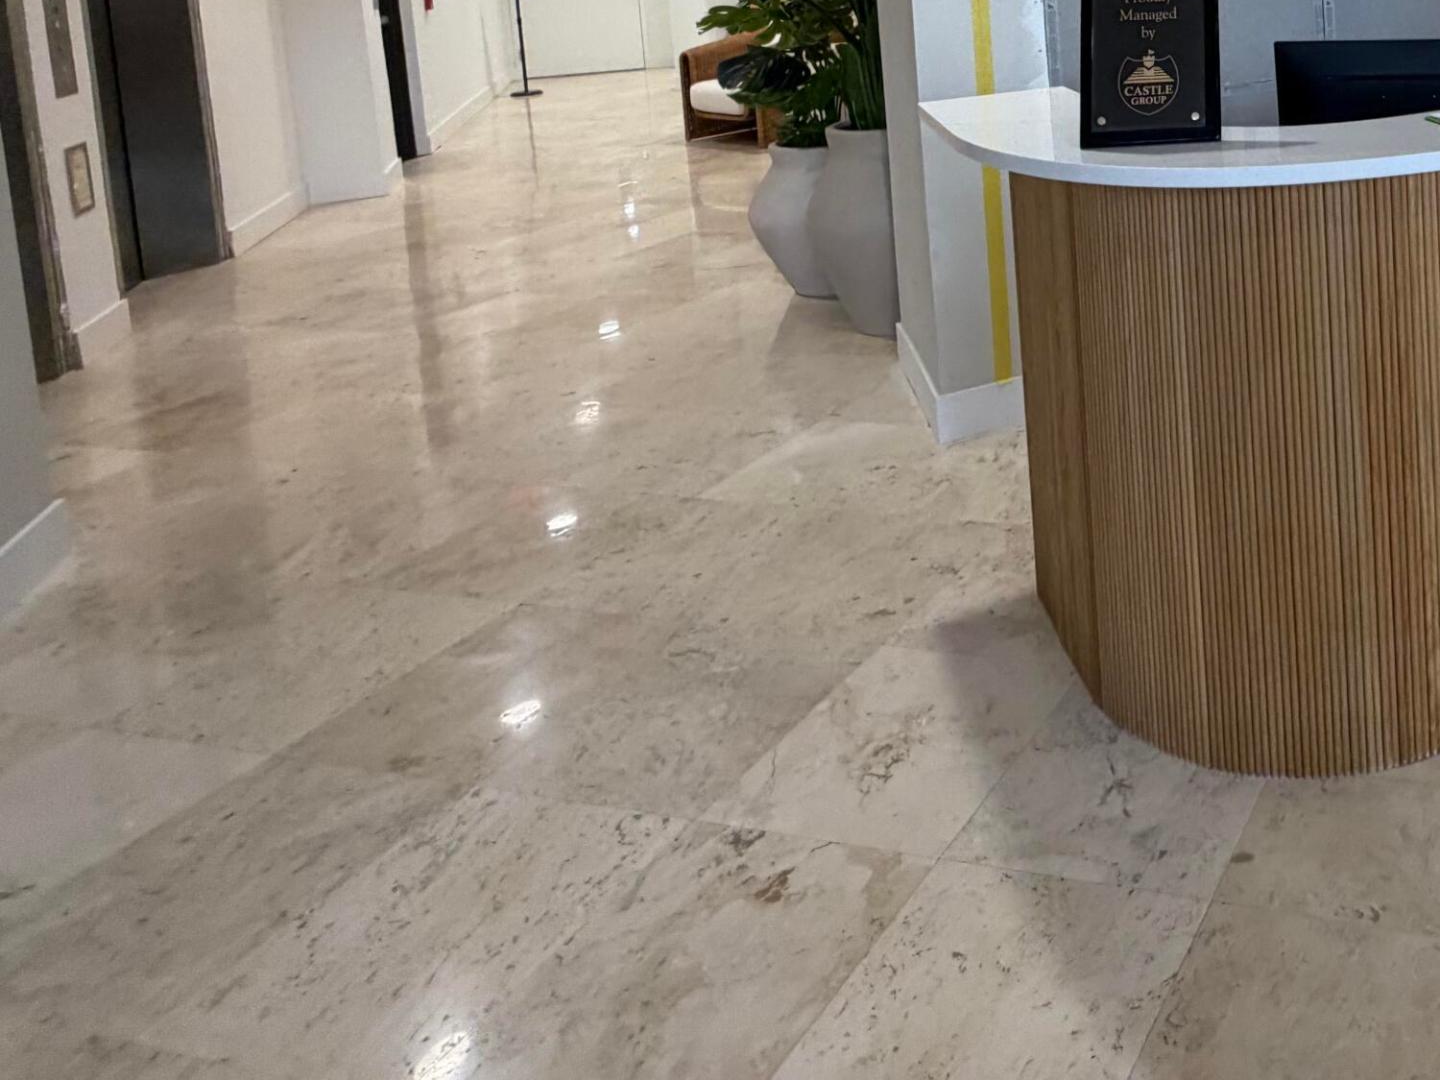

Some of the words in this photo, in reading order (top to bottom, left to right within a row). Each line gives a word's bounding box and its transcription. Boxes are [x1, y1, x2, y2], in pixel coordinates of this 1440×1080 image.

[1120, 6, 1177, 23] Managed
[1141, 26, 1155, 40] by
[1124, 84, 1173, 97] CASTLE
[1130, 95, 1167, 106] GROUP
